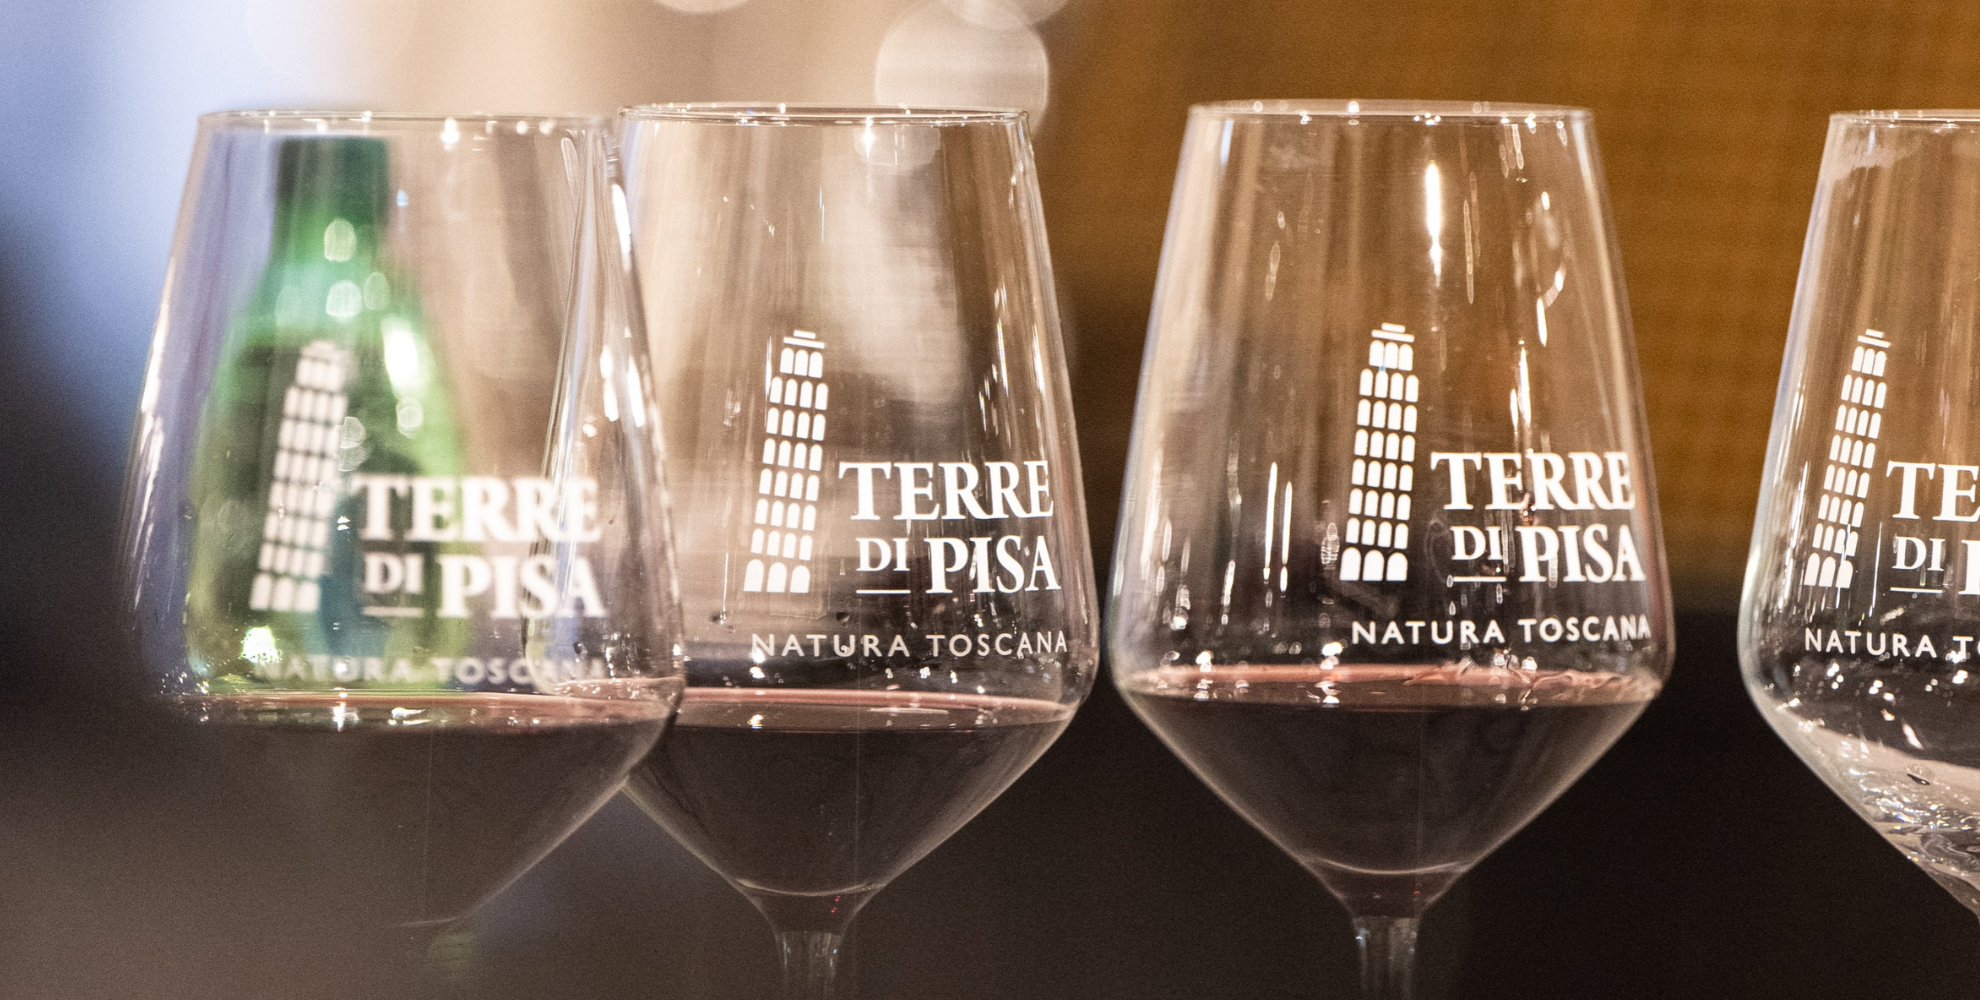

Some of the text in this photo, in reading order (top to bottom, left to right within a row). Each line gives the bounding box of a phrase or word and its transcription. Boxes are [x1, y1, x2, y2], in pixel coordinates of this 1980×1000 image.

[352, 474, 601, 543] TERRE
[838, 460, 1053, 521] TERRE
[1430, 451, 1635, 510] TERRE
[855, 535, 1061, 594] DI PISA
[1450, 524, 1647, 583] DI PISA
[1892, 536, 1946, 571] DI
[363, 553, 607, 619] DI PISA
[751, 630, 1068, 658] NATURA TOSCANA
[1351, 615, 1651, 645] NATURA TOSCANA
[1805, 627, 1937, 659] NATURA
